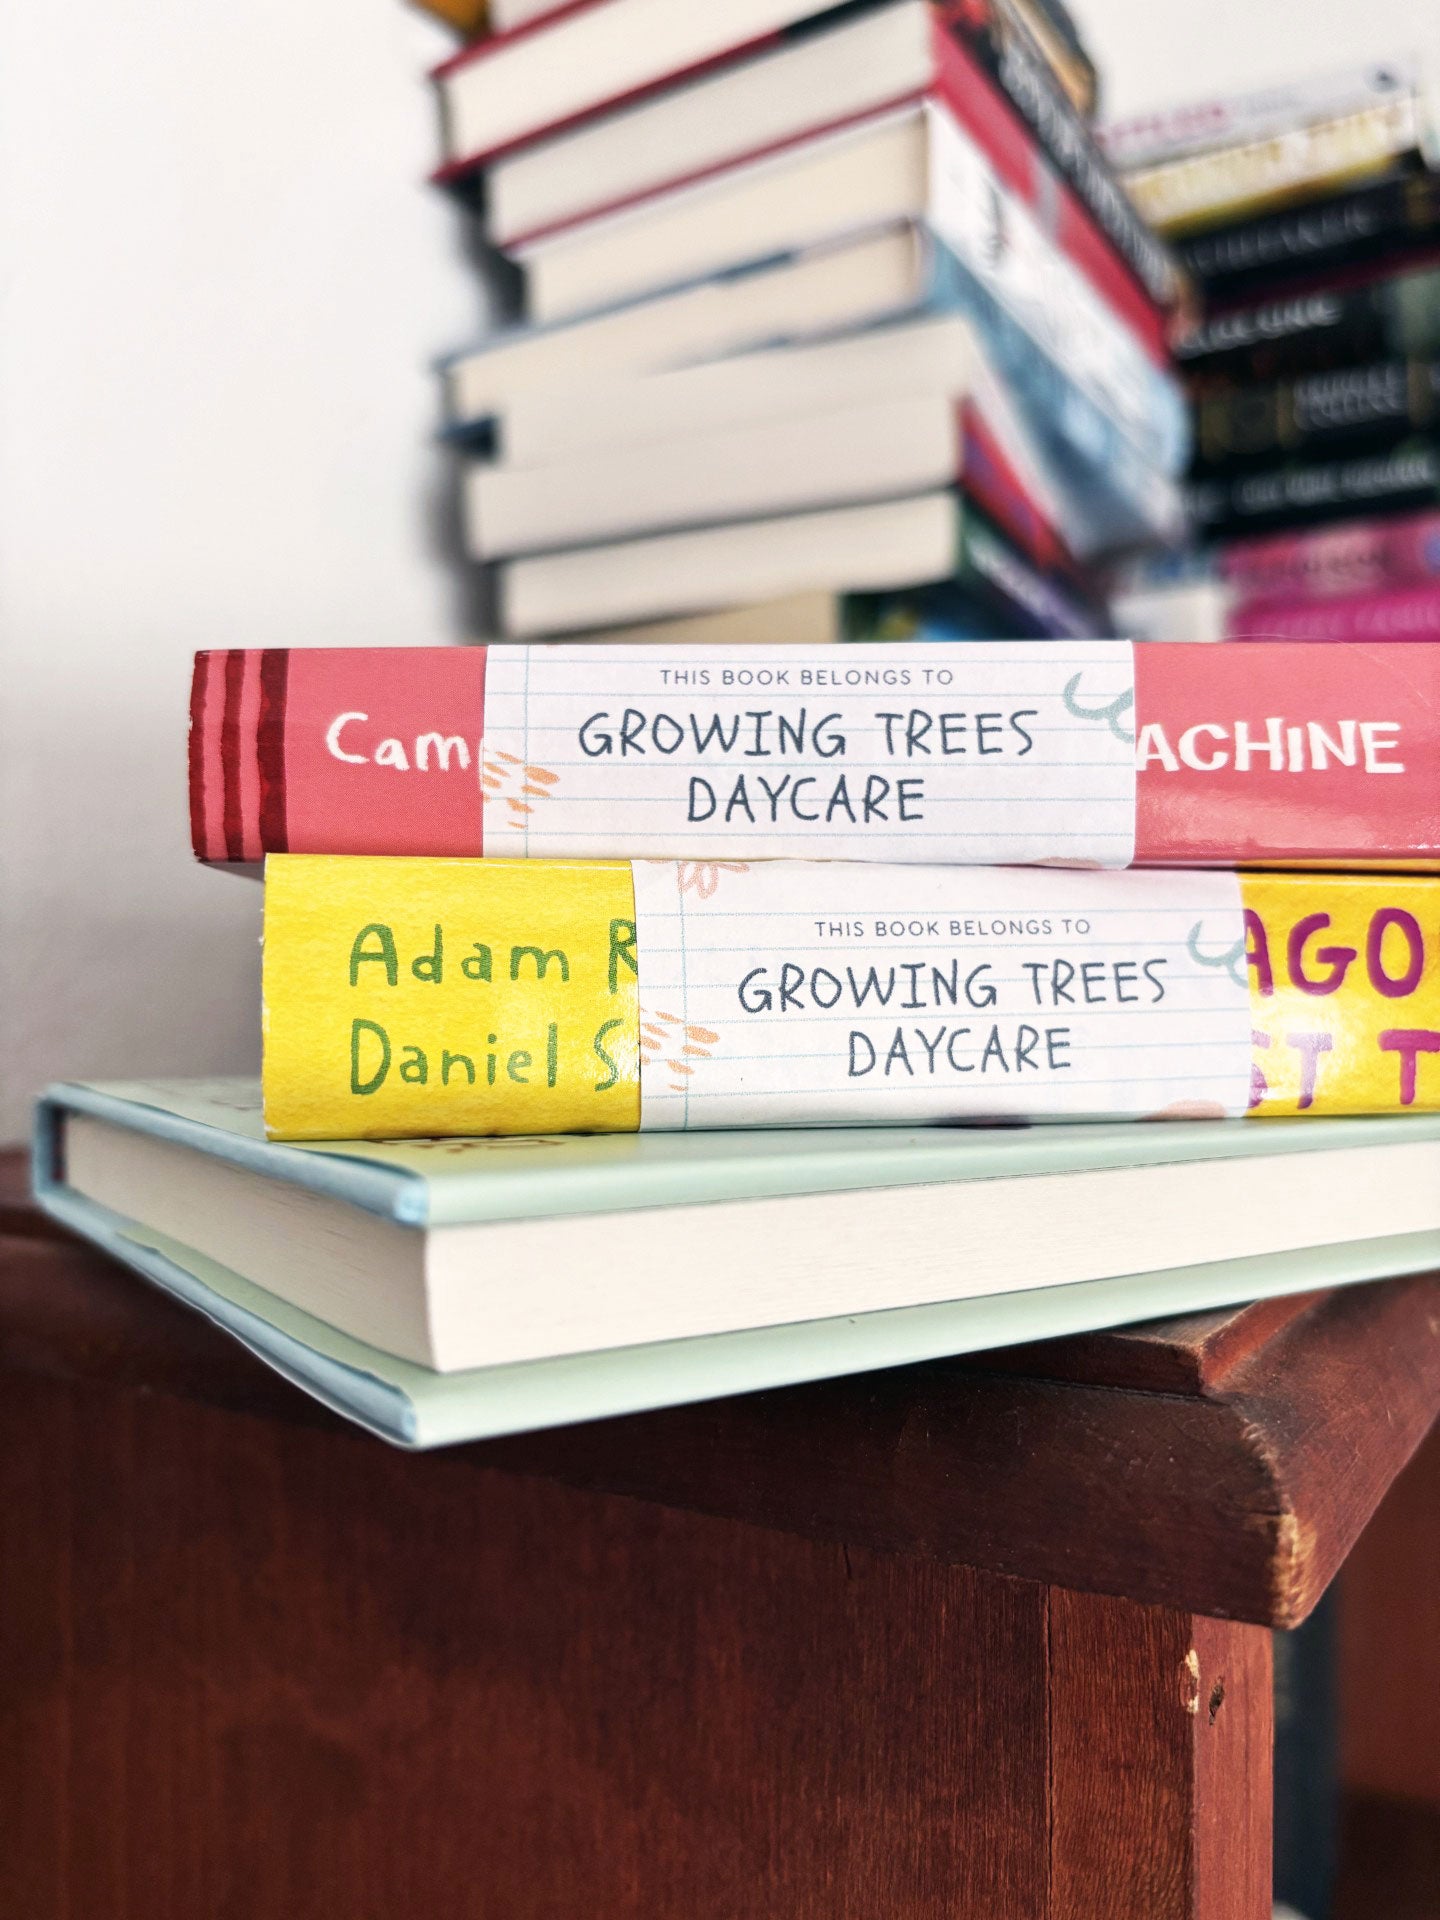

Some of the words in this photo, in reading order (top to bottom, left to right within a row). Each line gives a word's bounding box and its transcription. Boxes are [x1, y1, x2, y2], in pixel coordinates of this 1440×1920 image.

[660, 669, 711, 685] THIS
[722, 669, 789, 686] BOOK
[801, 669, 911, 686] BELONGS
[924, 669, 953, 685] TO
[325, 711, 484, 792] Cam
[578, 707, 846, 758] GROWING
[875, 708, 1038, 757] TREES
[1137, 718, 1405, 775] ACHINE
[687, 773, 925, 824] DAYCARE
[349, 923, 569, 987] Adam
[814, 921, 864, 937] THIS
[875, 920, 939, 937] BOOK
[949, 919, 1052, 936] BELONGS
[1061, 919, 1090, 935] TO
[738, 958, 997, 1014] GROWING
[1022, 959, 1168, 1006] TREES
[350, 1018, 558, 1095] Daniel
[848, 1025, 1072, 1078] DAYCARE
